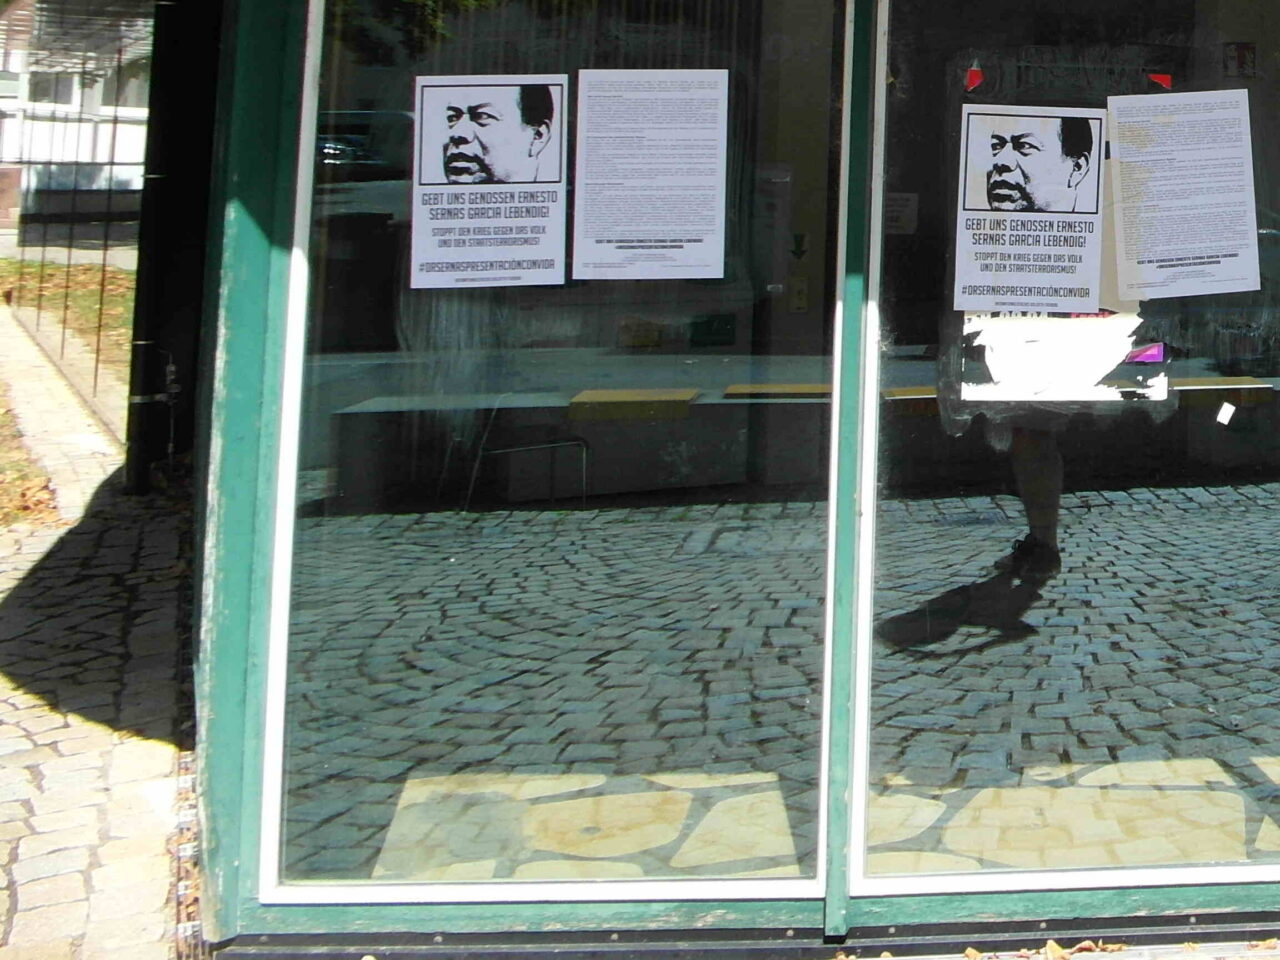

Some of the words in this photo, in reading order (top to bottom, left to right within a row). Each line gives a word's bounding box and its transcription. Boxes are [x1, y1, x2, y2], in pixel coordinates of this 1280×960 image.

[422, 192, 444, 206] GEBT
[447, 192, 466, 205] UNS
[468, 191, 516, 205] GENOSSEN
[518, 191, 558, 204] ERNESTO
[429, 207, 465, 220] SERNAS
[468, 206, 501, 220] GARCIA
[504, 206, 550, 219] LEBENDIG!
[432, 227, 456, 236] STOPPT
[458, 227, 471, 236] DEN
[473, 227, 492, 236] KRIEG
[493, 226, 514, 235] GEGEN
[515, 226, 528, 235] DAS
[530, 225, 546, 234] VOLK
[965, 218, 987, 231] GEBT
[989, 218, 1007, 231] UNS
[1010, 219, 1054, 233] GENOSSEN
[1057, 220, 1094, 234] ERNESTO
[438, 239, 452, 248] UND
[454, 238, 467, 247] DEN
[972, 233, 1006, 246] SERNAS
[1009, 234, 1041, 247] GARCIA
[1043, 235, 1087, 248] LEBENDIG!
[974, 252, 998, 261] STOPPT
[1000, 252, 1012, 261] DEN
[1013, 253, 1031, 262] KRIEG
[1032, 254, 1052, 263] GEGEN
[1053, 254, 1066, 263] DAS
[1067, 255, 1082, 264] VOLK
[980, 263, 993, 272] UND
[995, 263, 1007, 272] DEN
[1008, 264, 1076, 274] STAATSTERRORISMUS!
